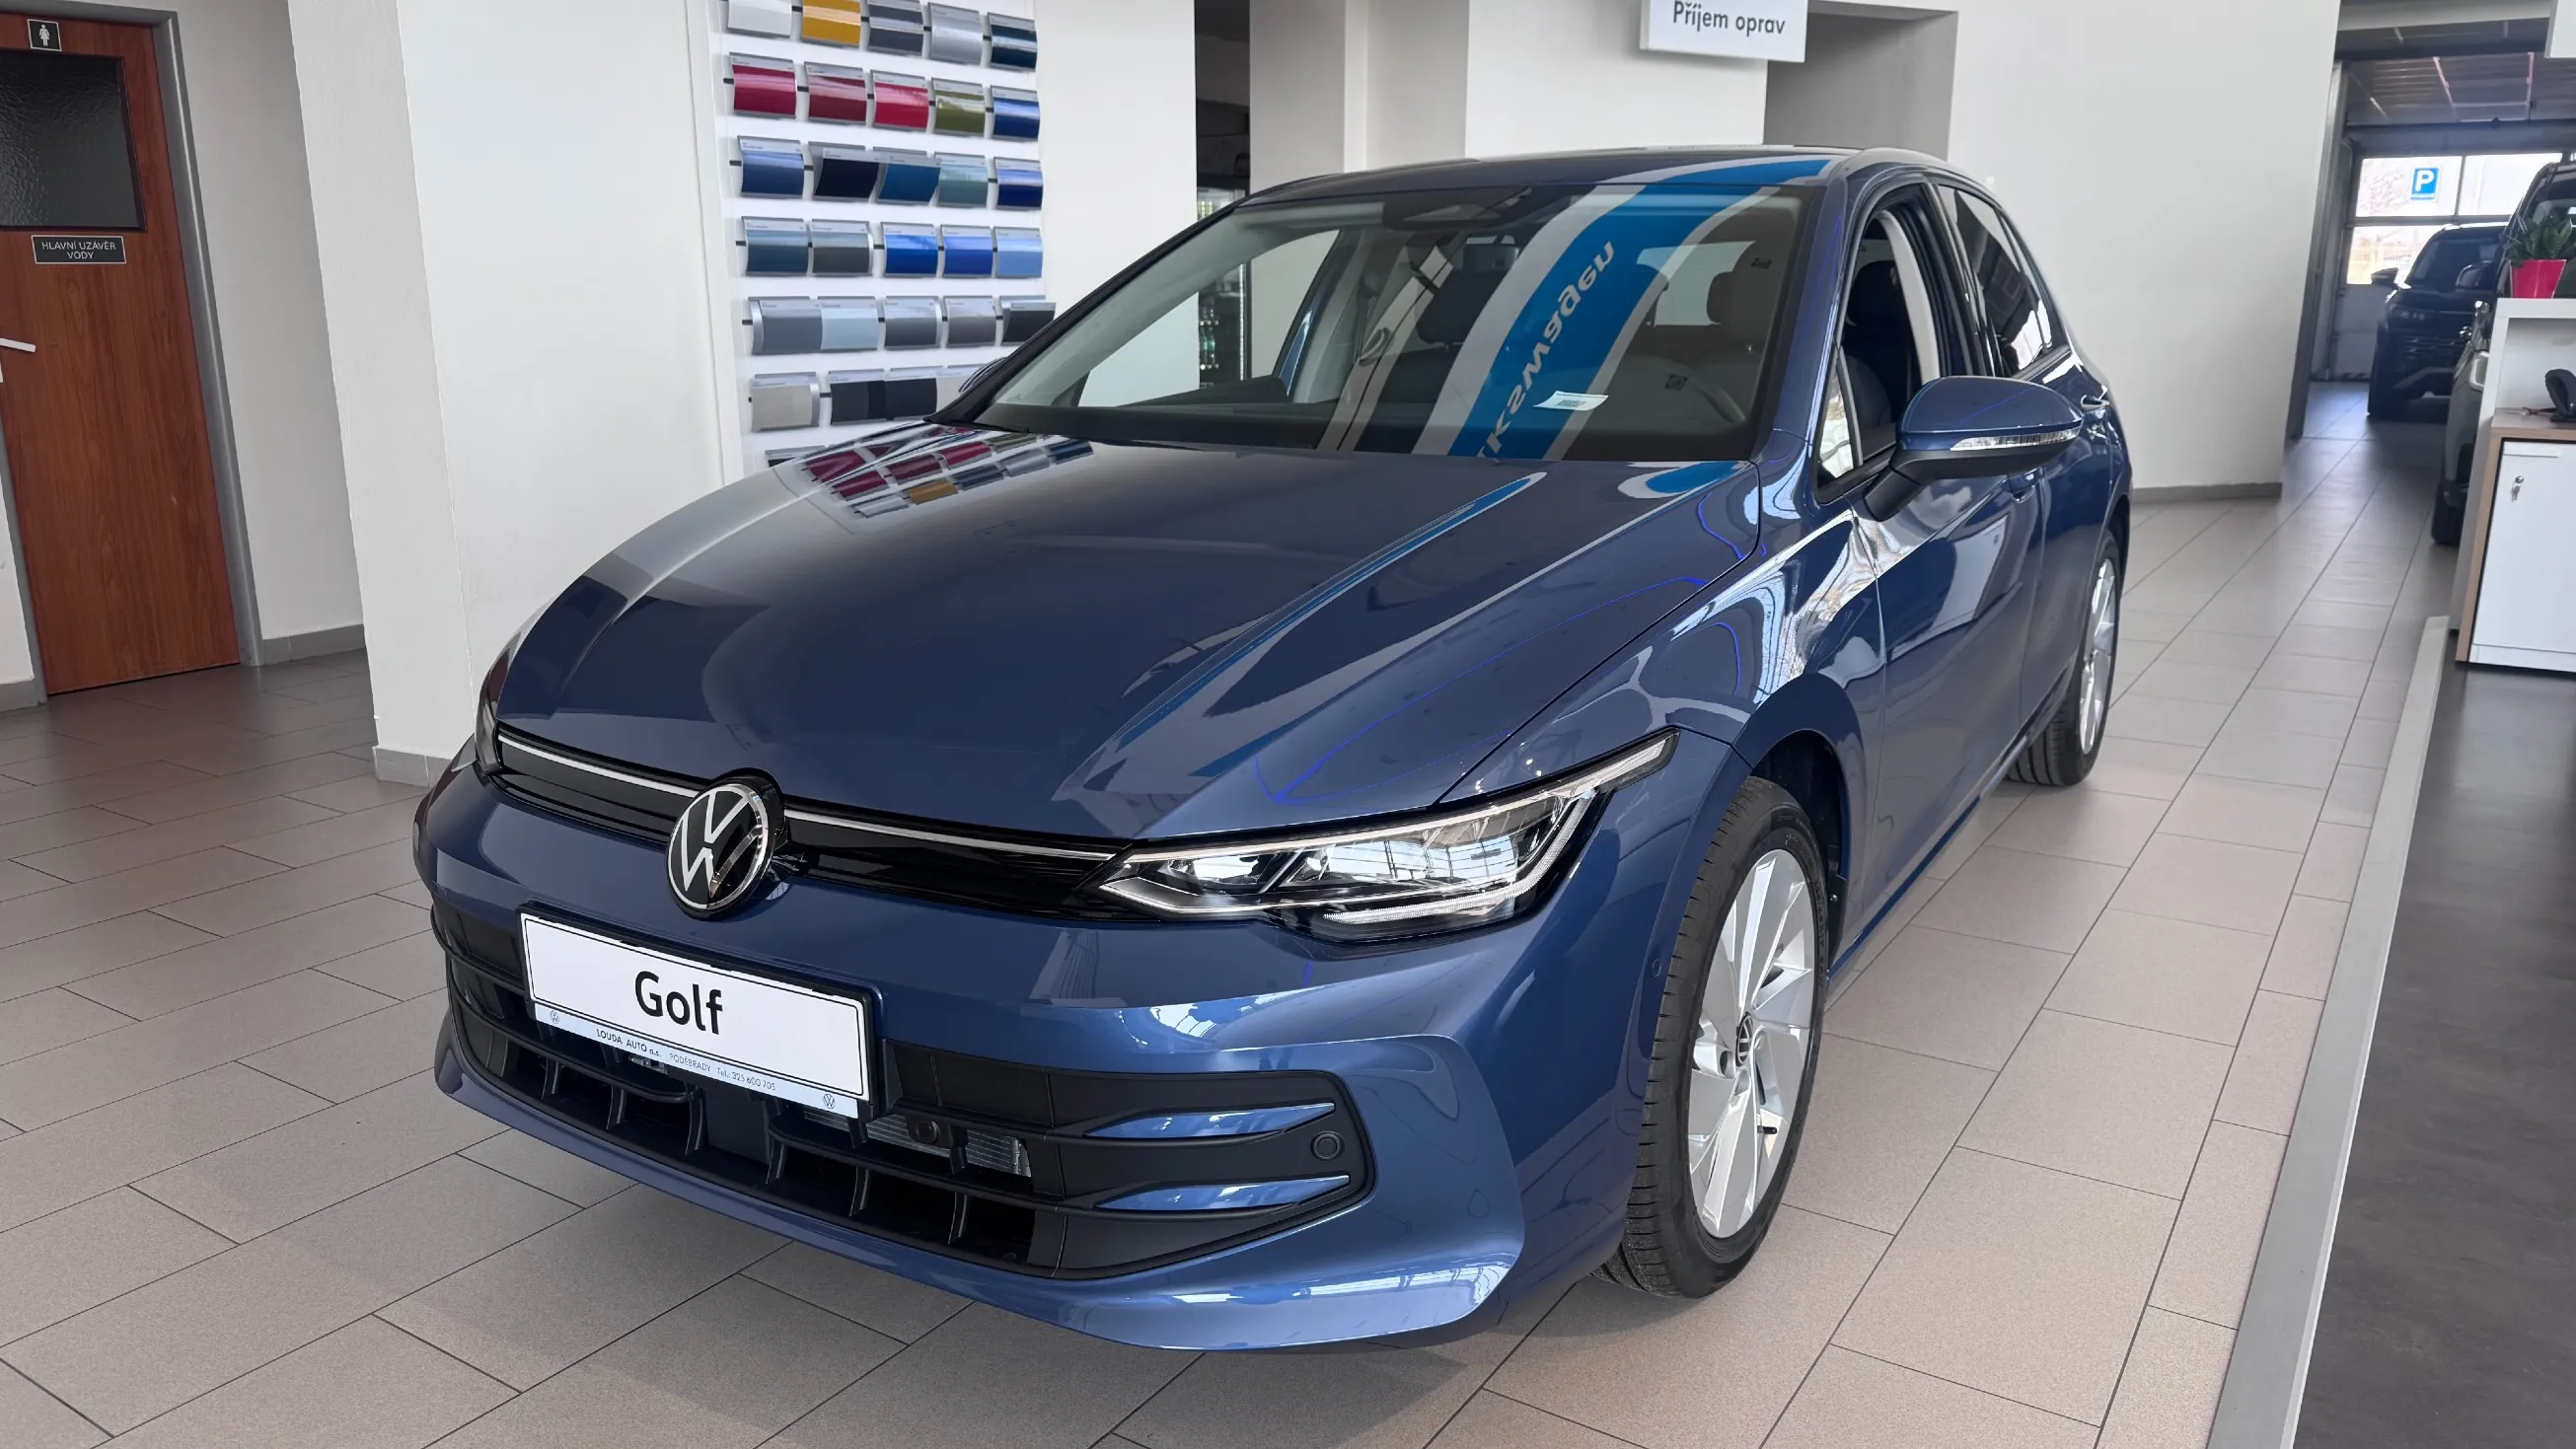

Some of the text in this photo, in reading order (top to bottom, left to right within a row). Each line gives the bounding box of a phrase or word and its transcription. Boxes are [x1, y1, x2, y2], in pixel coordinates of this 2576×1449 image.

[1673, 0, 1785, 37] Příjem oprav
[2414, 170, 2435, 192] P
[41, 240, 116, 251] HLAVNÍ UZÁVĚR
[66, 251, 95, 259] VODY
[634, 971, 723, 1036] Golf
[596, 1028, 623, 1046] LOUDA
[626, 1038, 647, 1052] AUTO
[649, 1049, 662, 1057] a.s.
[716, 1066, 731, 1079] Tel.:
[732, 1071, 746, 1083] 325
[746, 1076, 762, 1087] 600
[763, 1080, 776, 1091] 705
